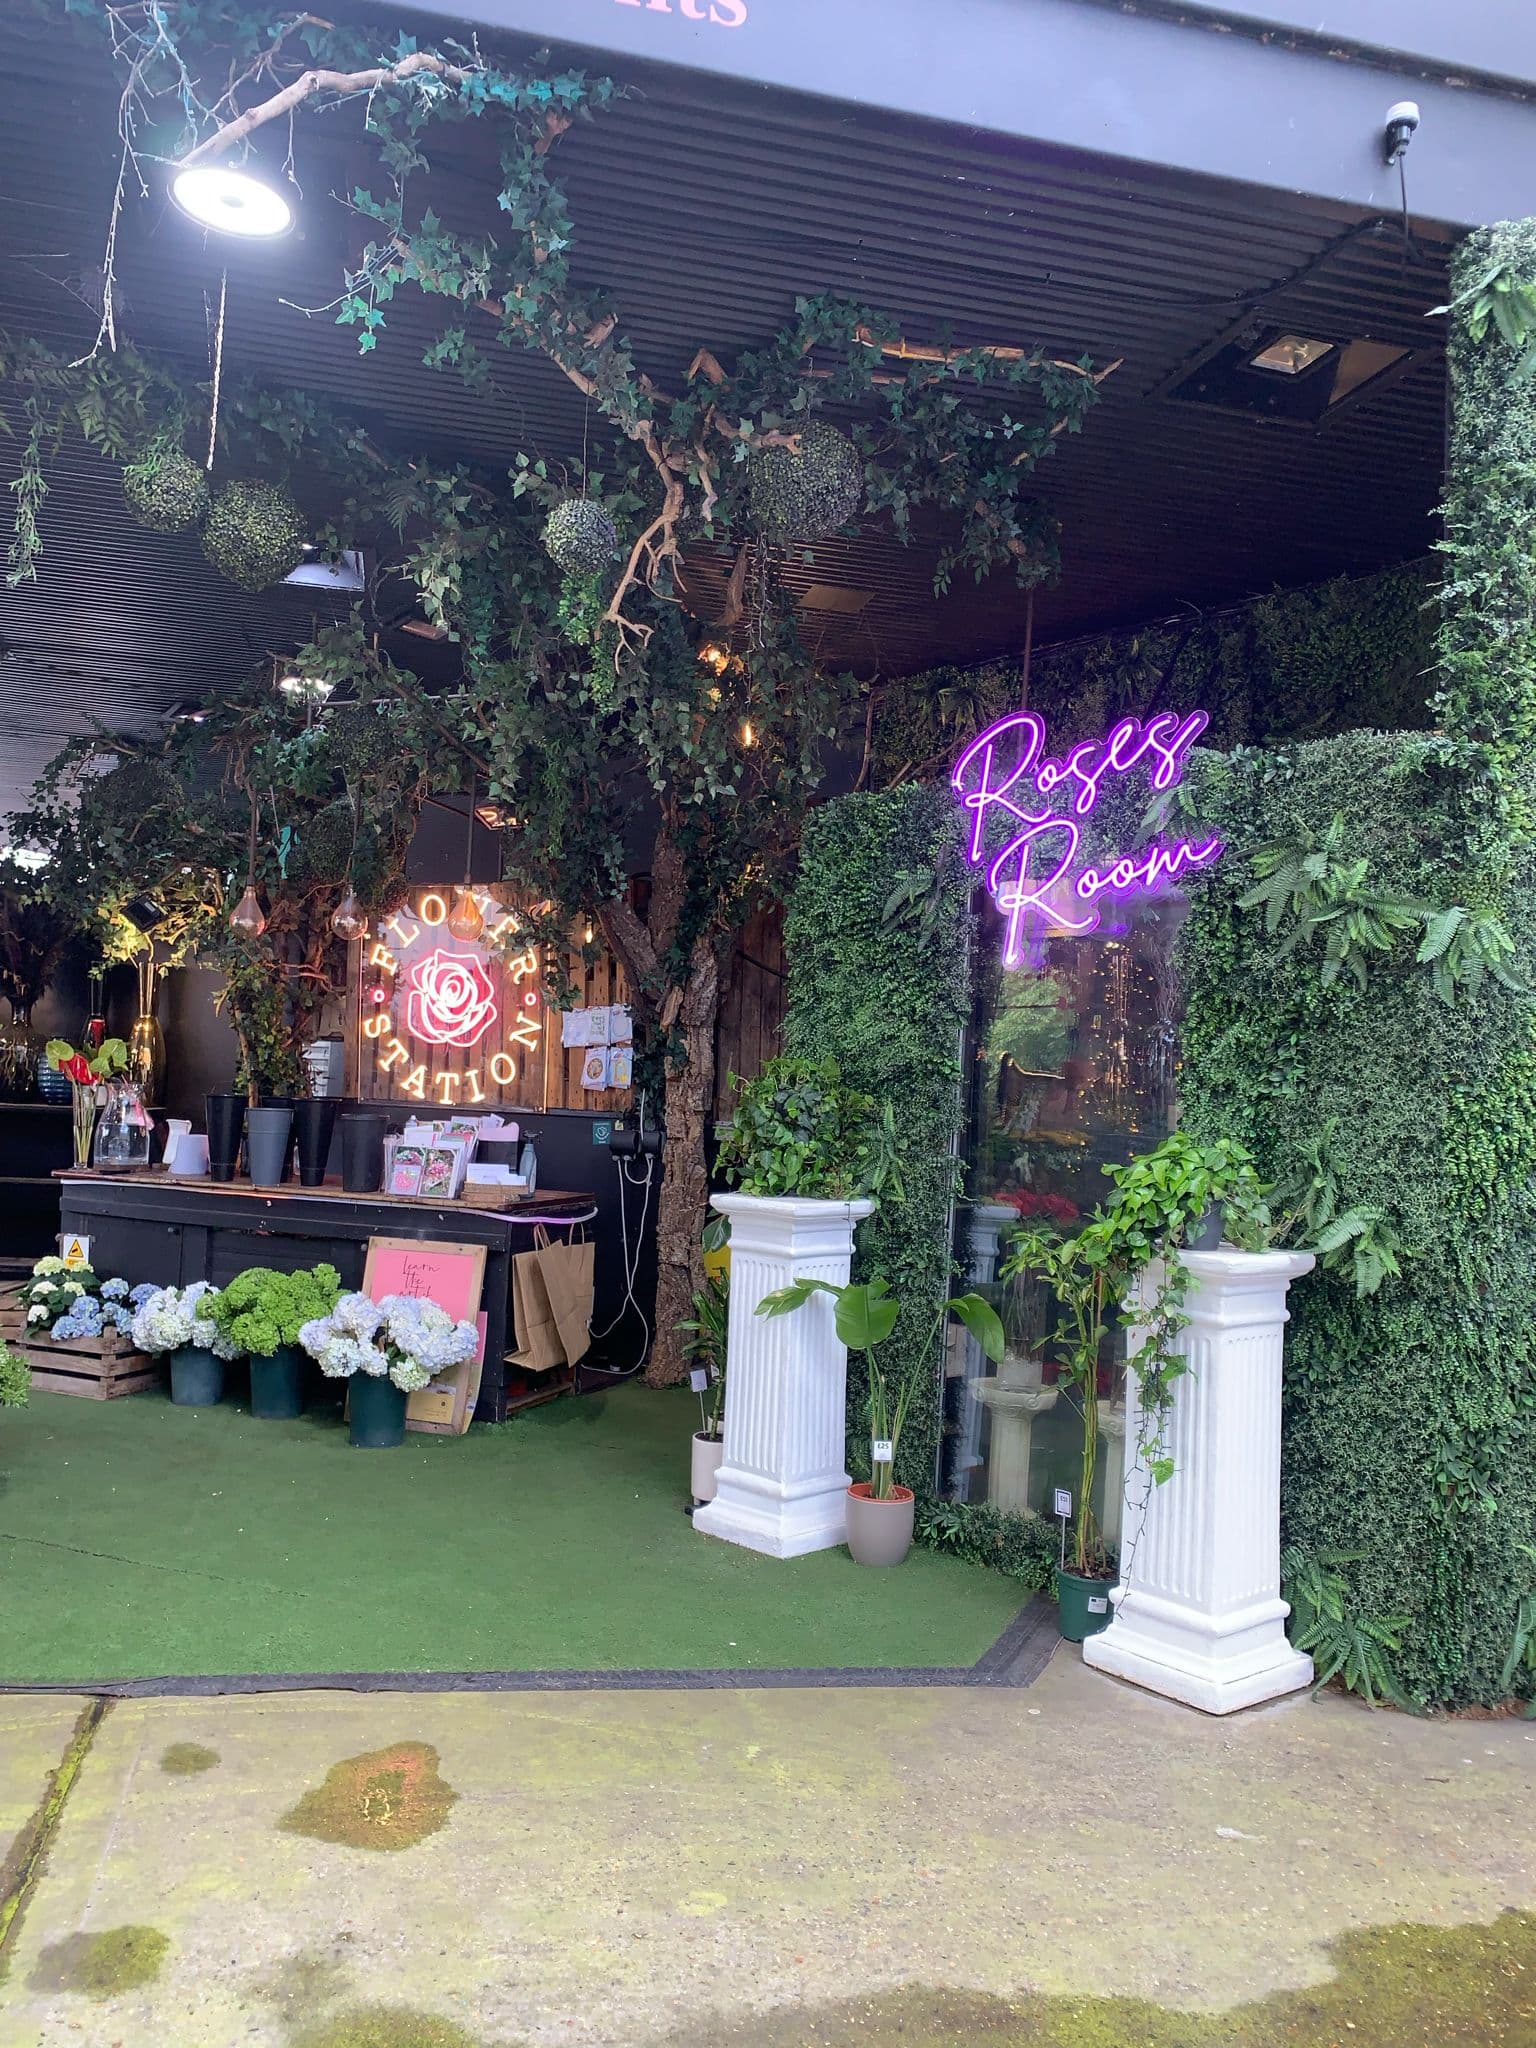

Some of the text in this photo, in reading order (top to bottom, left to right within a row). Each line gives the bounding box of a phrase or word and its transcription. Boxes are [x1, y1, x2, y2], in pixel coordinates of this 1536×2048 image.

[955, 715, 1204, 863] Roses
[989, 818, 1219, 966] Room
[363, 1010, 542, 1106] STATION
